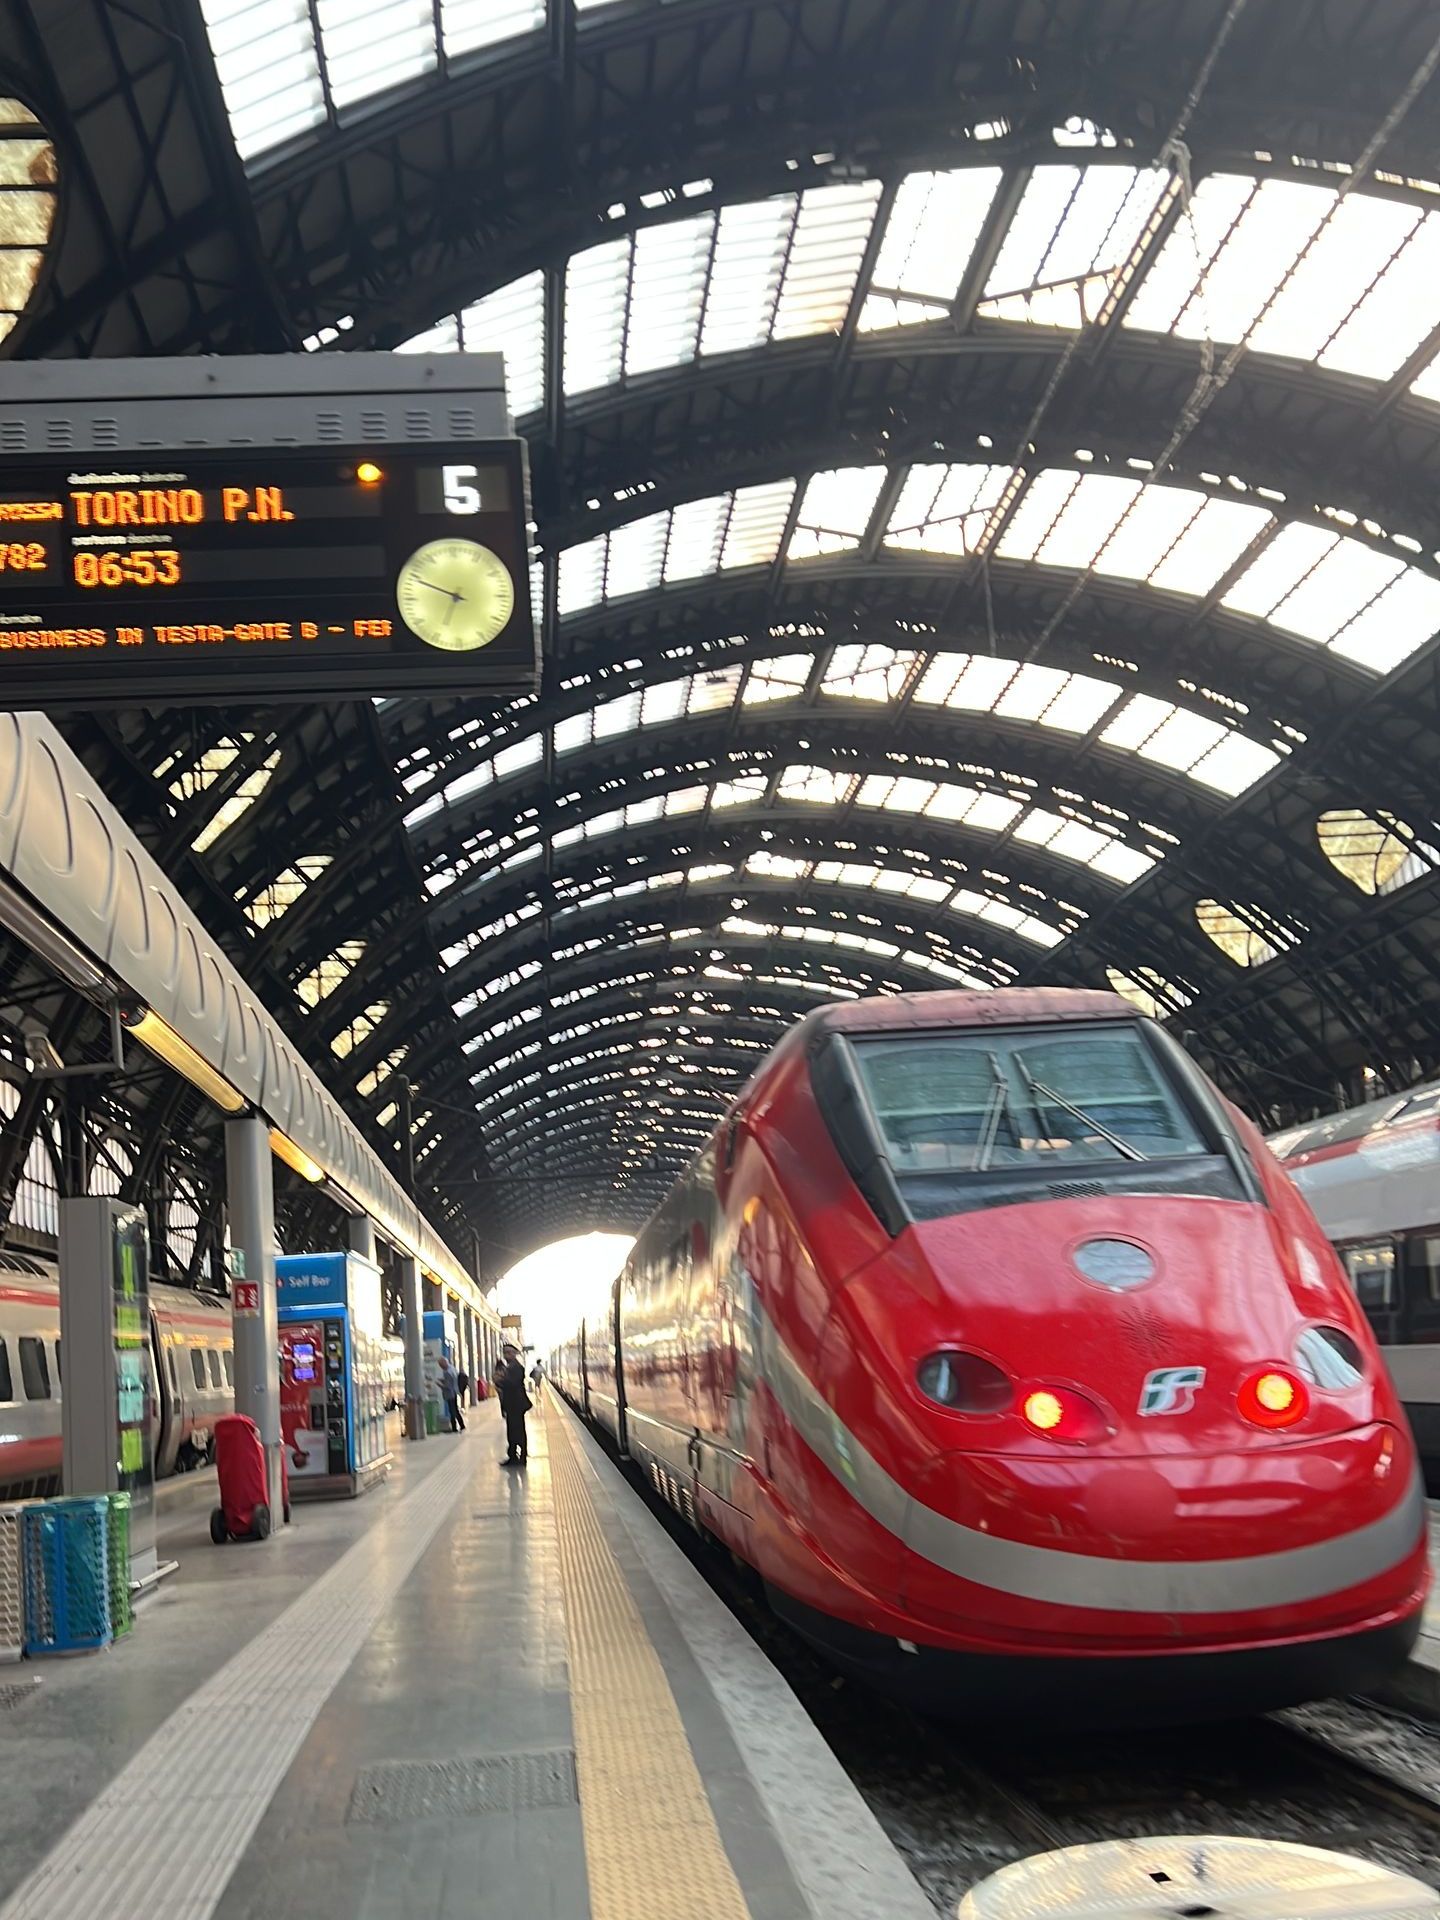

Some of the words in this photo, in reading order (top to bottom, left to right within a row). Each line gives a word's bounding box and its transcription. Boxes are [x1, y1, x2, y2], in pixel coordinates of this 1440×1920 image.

[70, 489, 203, 525] TORINO
[222, 487, 296, 522] P.N.
[442, 465, 481, 515] 5
[74, 550, 181, 586] 06:53
[0, 629, 107, 648] BUSINESS
[116, 627, 143, 645] IN
